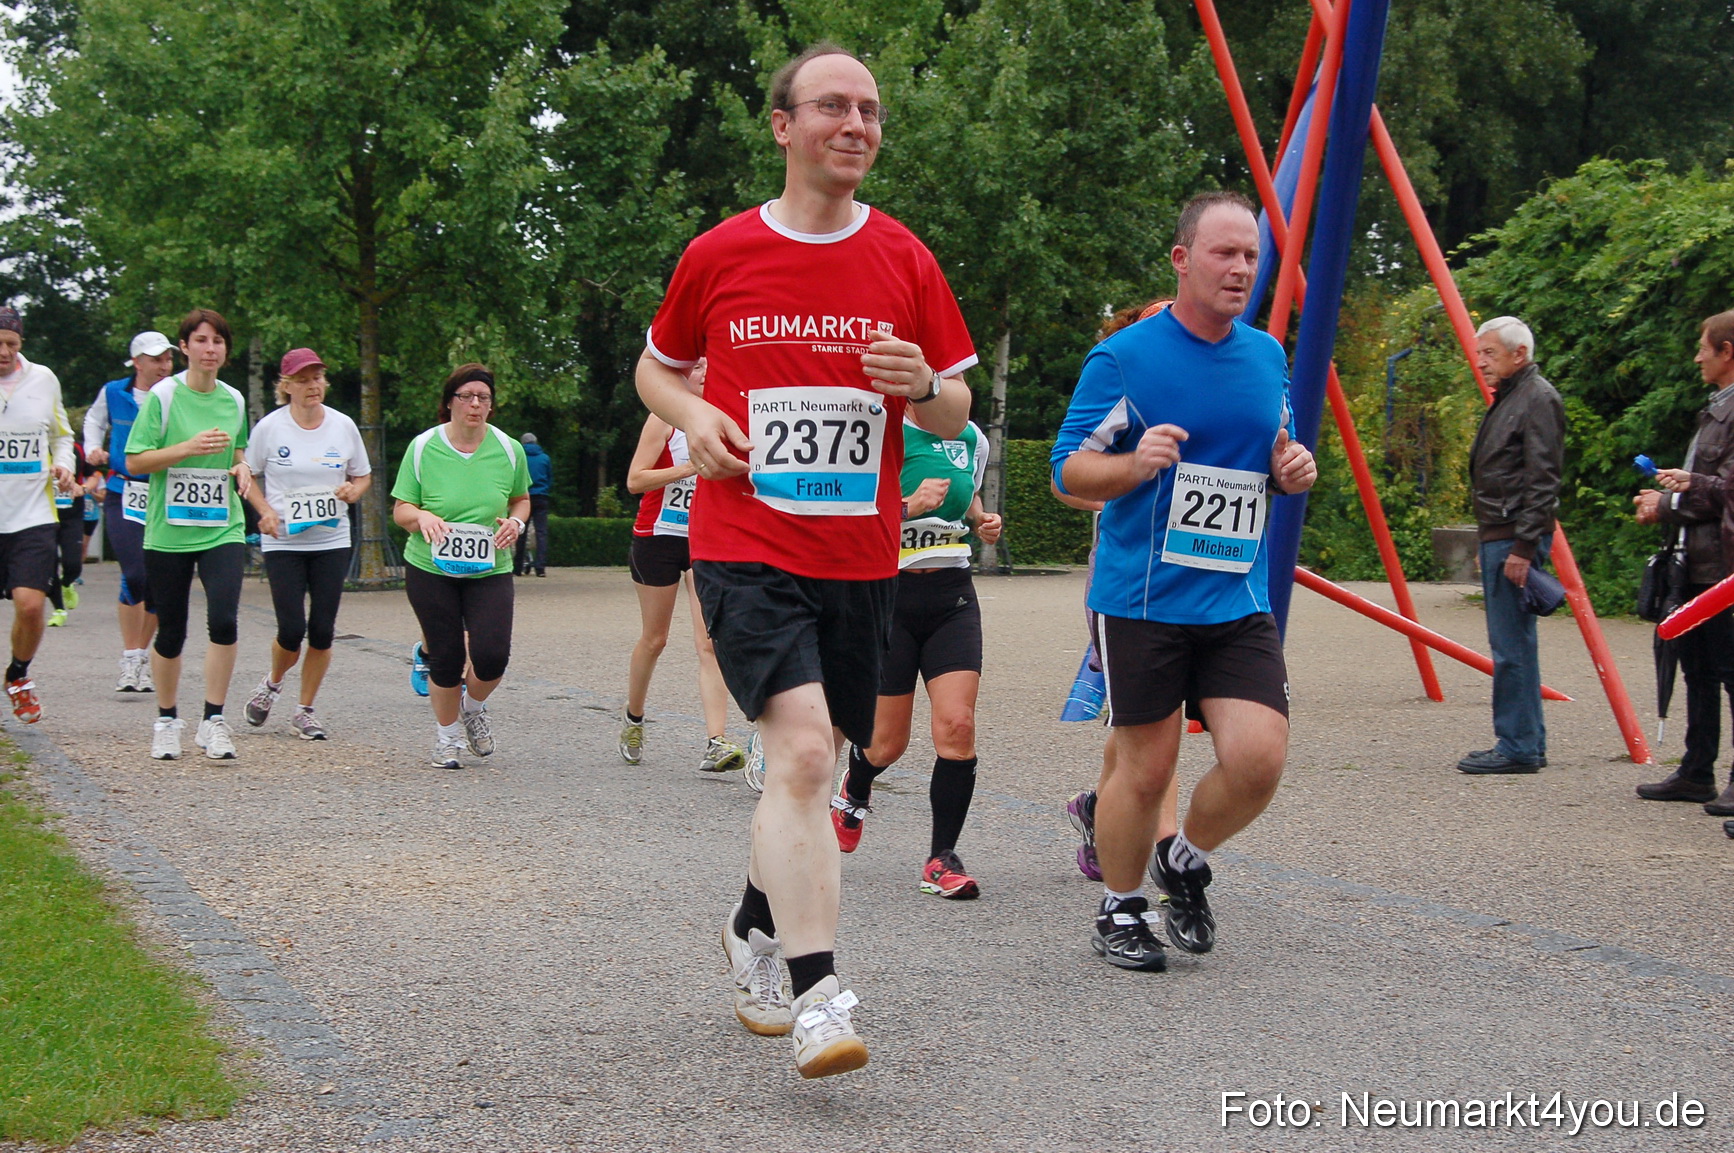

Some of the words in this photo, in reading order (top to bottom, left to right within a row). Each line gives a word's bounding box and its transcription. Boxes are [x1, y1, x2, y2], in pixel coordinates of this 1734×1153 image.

[729, 315, 872, 343] NEUMARKT
[811, 344, 844, 353] STARKE
[753, 401, 797, 414] PARTL
[800, 400, 864, 413] Neumarkt
[765, 419, 871, 467] 2373
[796, 478, 843, 497] Frank
[1178, 472, 1214, 487] PARTL
[1216, 478, 1257, 492] Neumarkt
[128, 492, 148, 510] 28
[173, 482, 224, 505] 2834
[669, 487, 695, 510] 26
[291, 498, 337, 520] 2180
[676, 514, 689, 524] Cla
[1180, 490, 1258, 534] 2211
[438, 536, 489, 559] 2830
[1192, 538, 1244, 558] Michael
